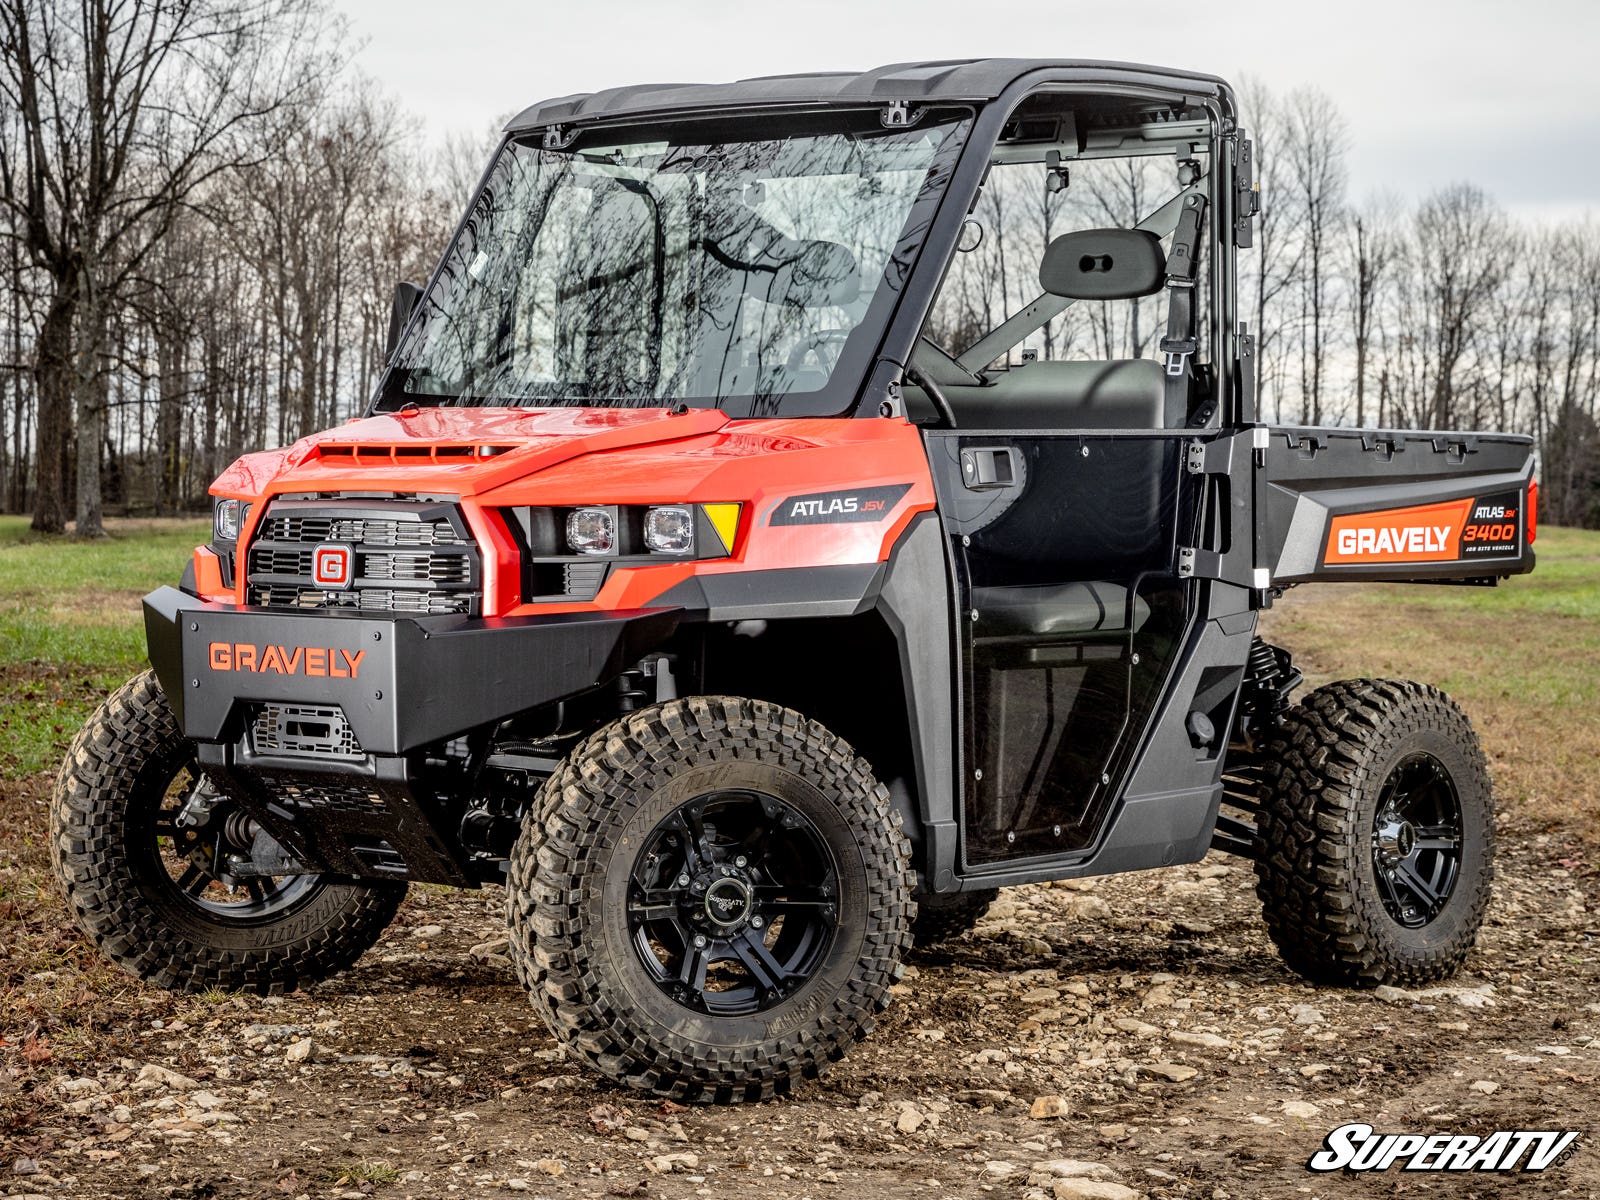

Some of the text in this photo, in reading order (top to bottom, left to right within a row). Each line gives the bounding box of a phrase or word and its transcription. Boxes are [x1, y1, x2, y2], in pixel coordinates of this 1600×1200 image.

[790, 497, 885, 518] ATLAS JSV
[1474, 506, 1504, 519] ATLAS
[1338, 526, 1451, 555] GRAVELY
[1463, 524, 1515, 541] 3400
[209, 642, 366, 679] GRAVELY
